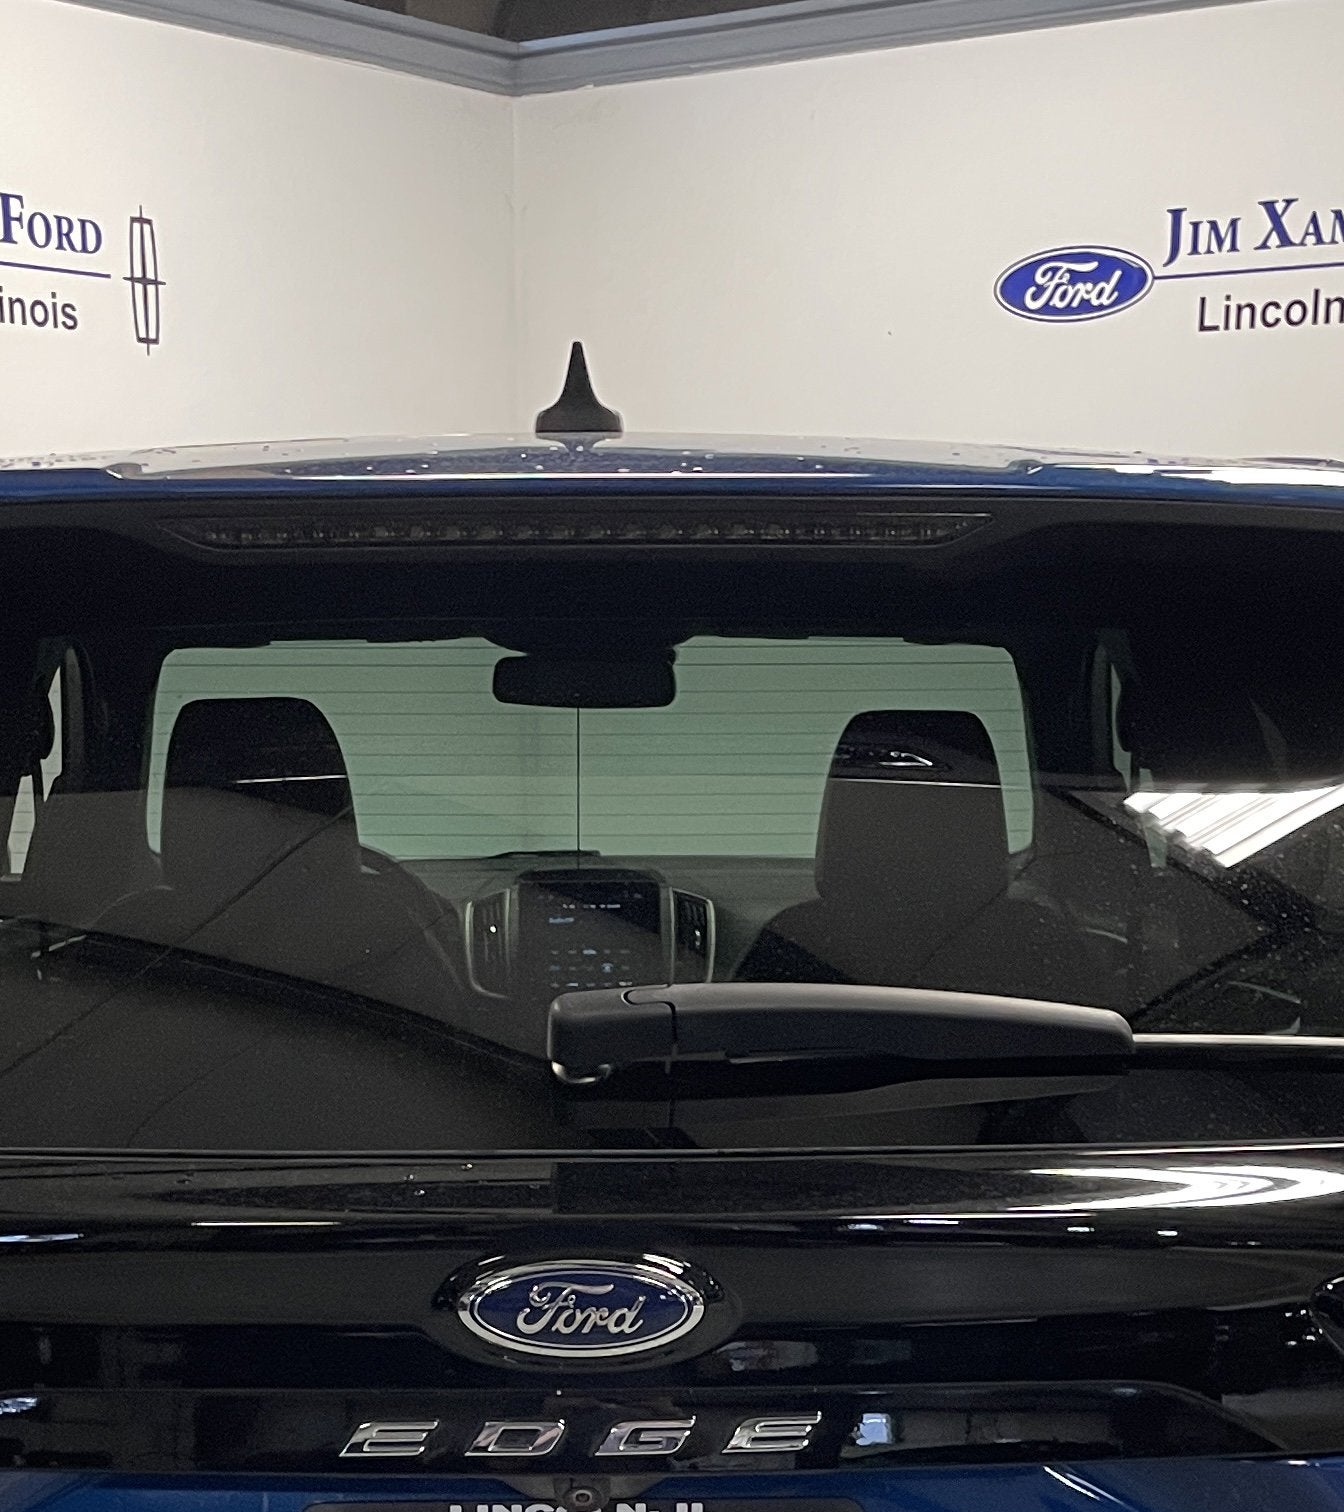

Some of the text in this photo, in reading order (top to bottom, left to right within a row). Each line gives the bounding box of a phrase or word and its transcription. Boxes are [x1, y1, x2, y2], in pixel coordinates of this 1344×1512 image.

[1162, 207, 1242, 267] JIM
[1024, 259, 1120, 310] Ford
[338, 1411, 823, 1458] EDGE
